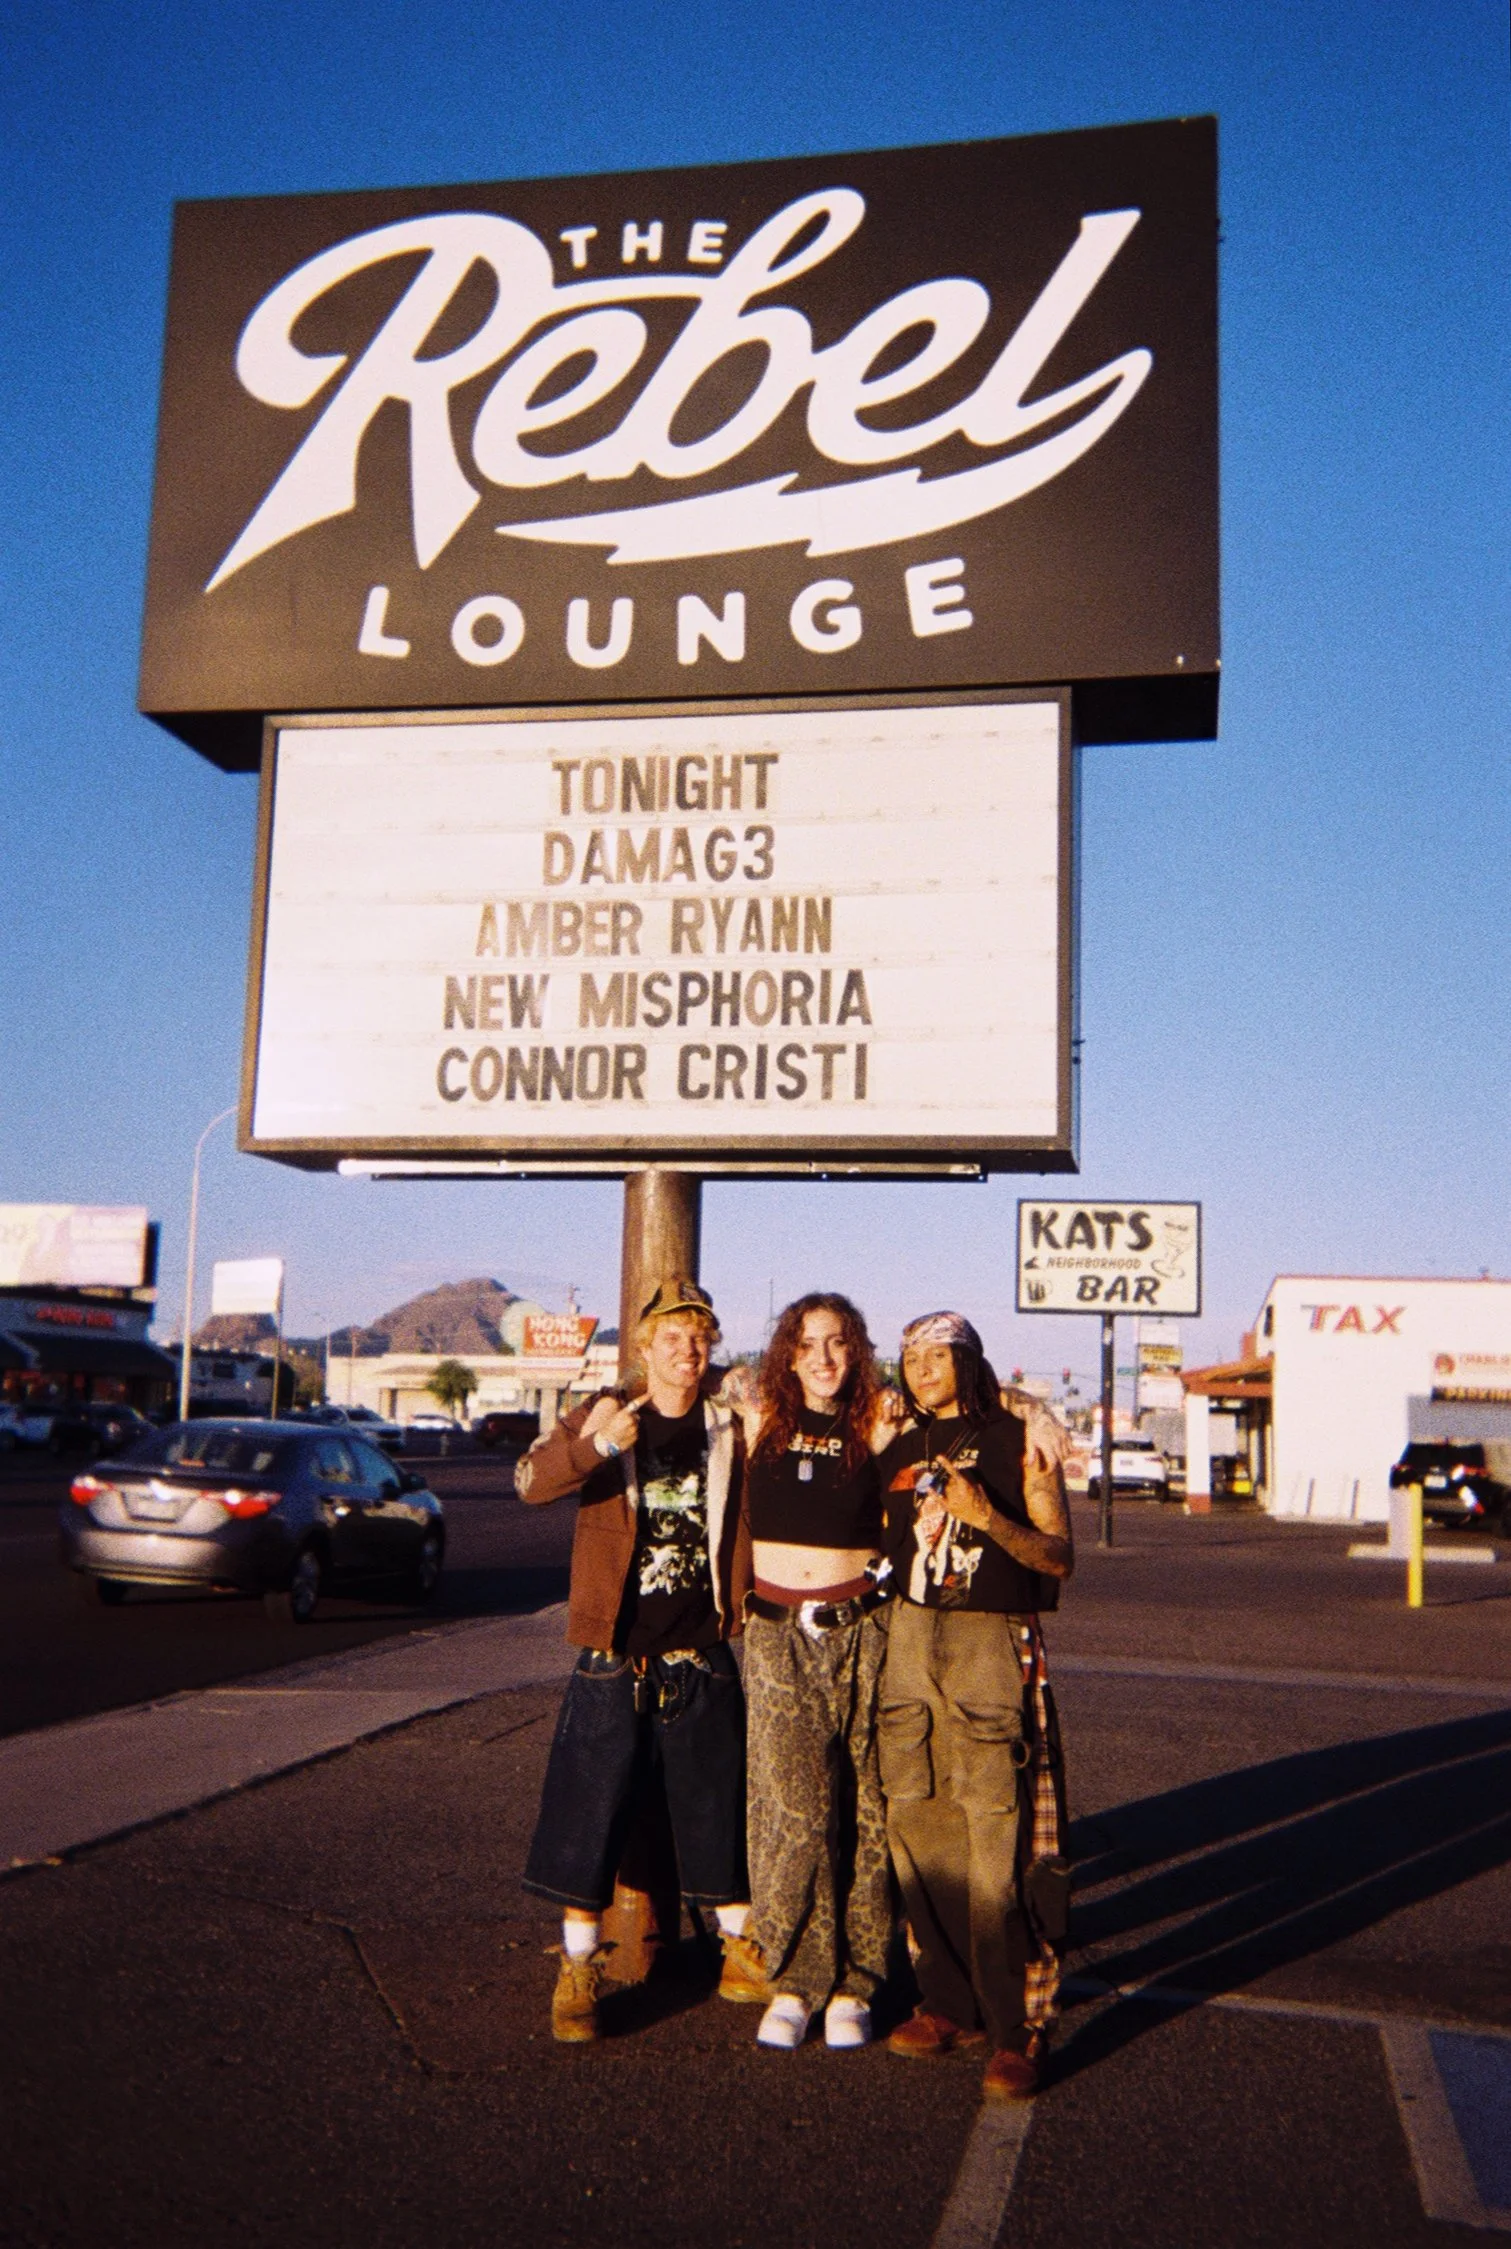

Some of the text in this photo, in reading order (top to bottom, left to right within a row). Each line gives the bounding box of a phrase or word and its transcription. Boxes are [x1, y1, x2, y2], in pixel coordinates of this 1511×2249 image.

[558, 219, 728, 270] THE
[206, 187, 1152, 592] Rebel
[357, 557, 975, 669] LOUNGE
[552, 752, 780, 816] TONIGHT
[543, 824, 776, 886] DAMAG3
[475, 896, 833, 957] AMBER RYANN
[443, 968, 873, 1030] NEW MISPHORIA
[436, 1042, 869, 1103] CONNOR CRISTI
[1030, 1209, 1153, 1251] KATS
[1046, 1256, 1142, 1270] NEIGHBORHOOD
[1076, 1274, 1161, 1305] BAR
[529, 1314, 580, 1333] HONG
[532, 1332, 587, 1349] KONG
[1301, 1304, 1406, 1336] TAX
